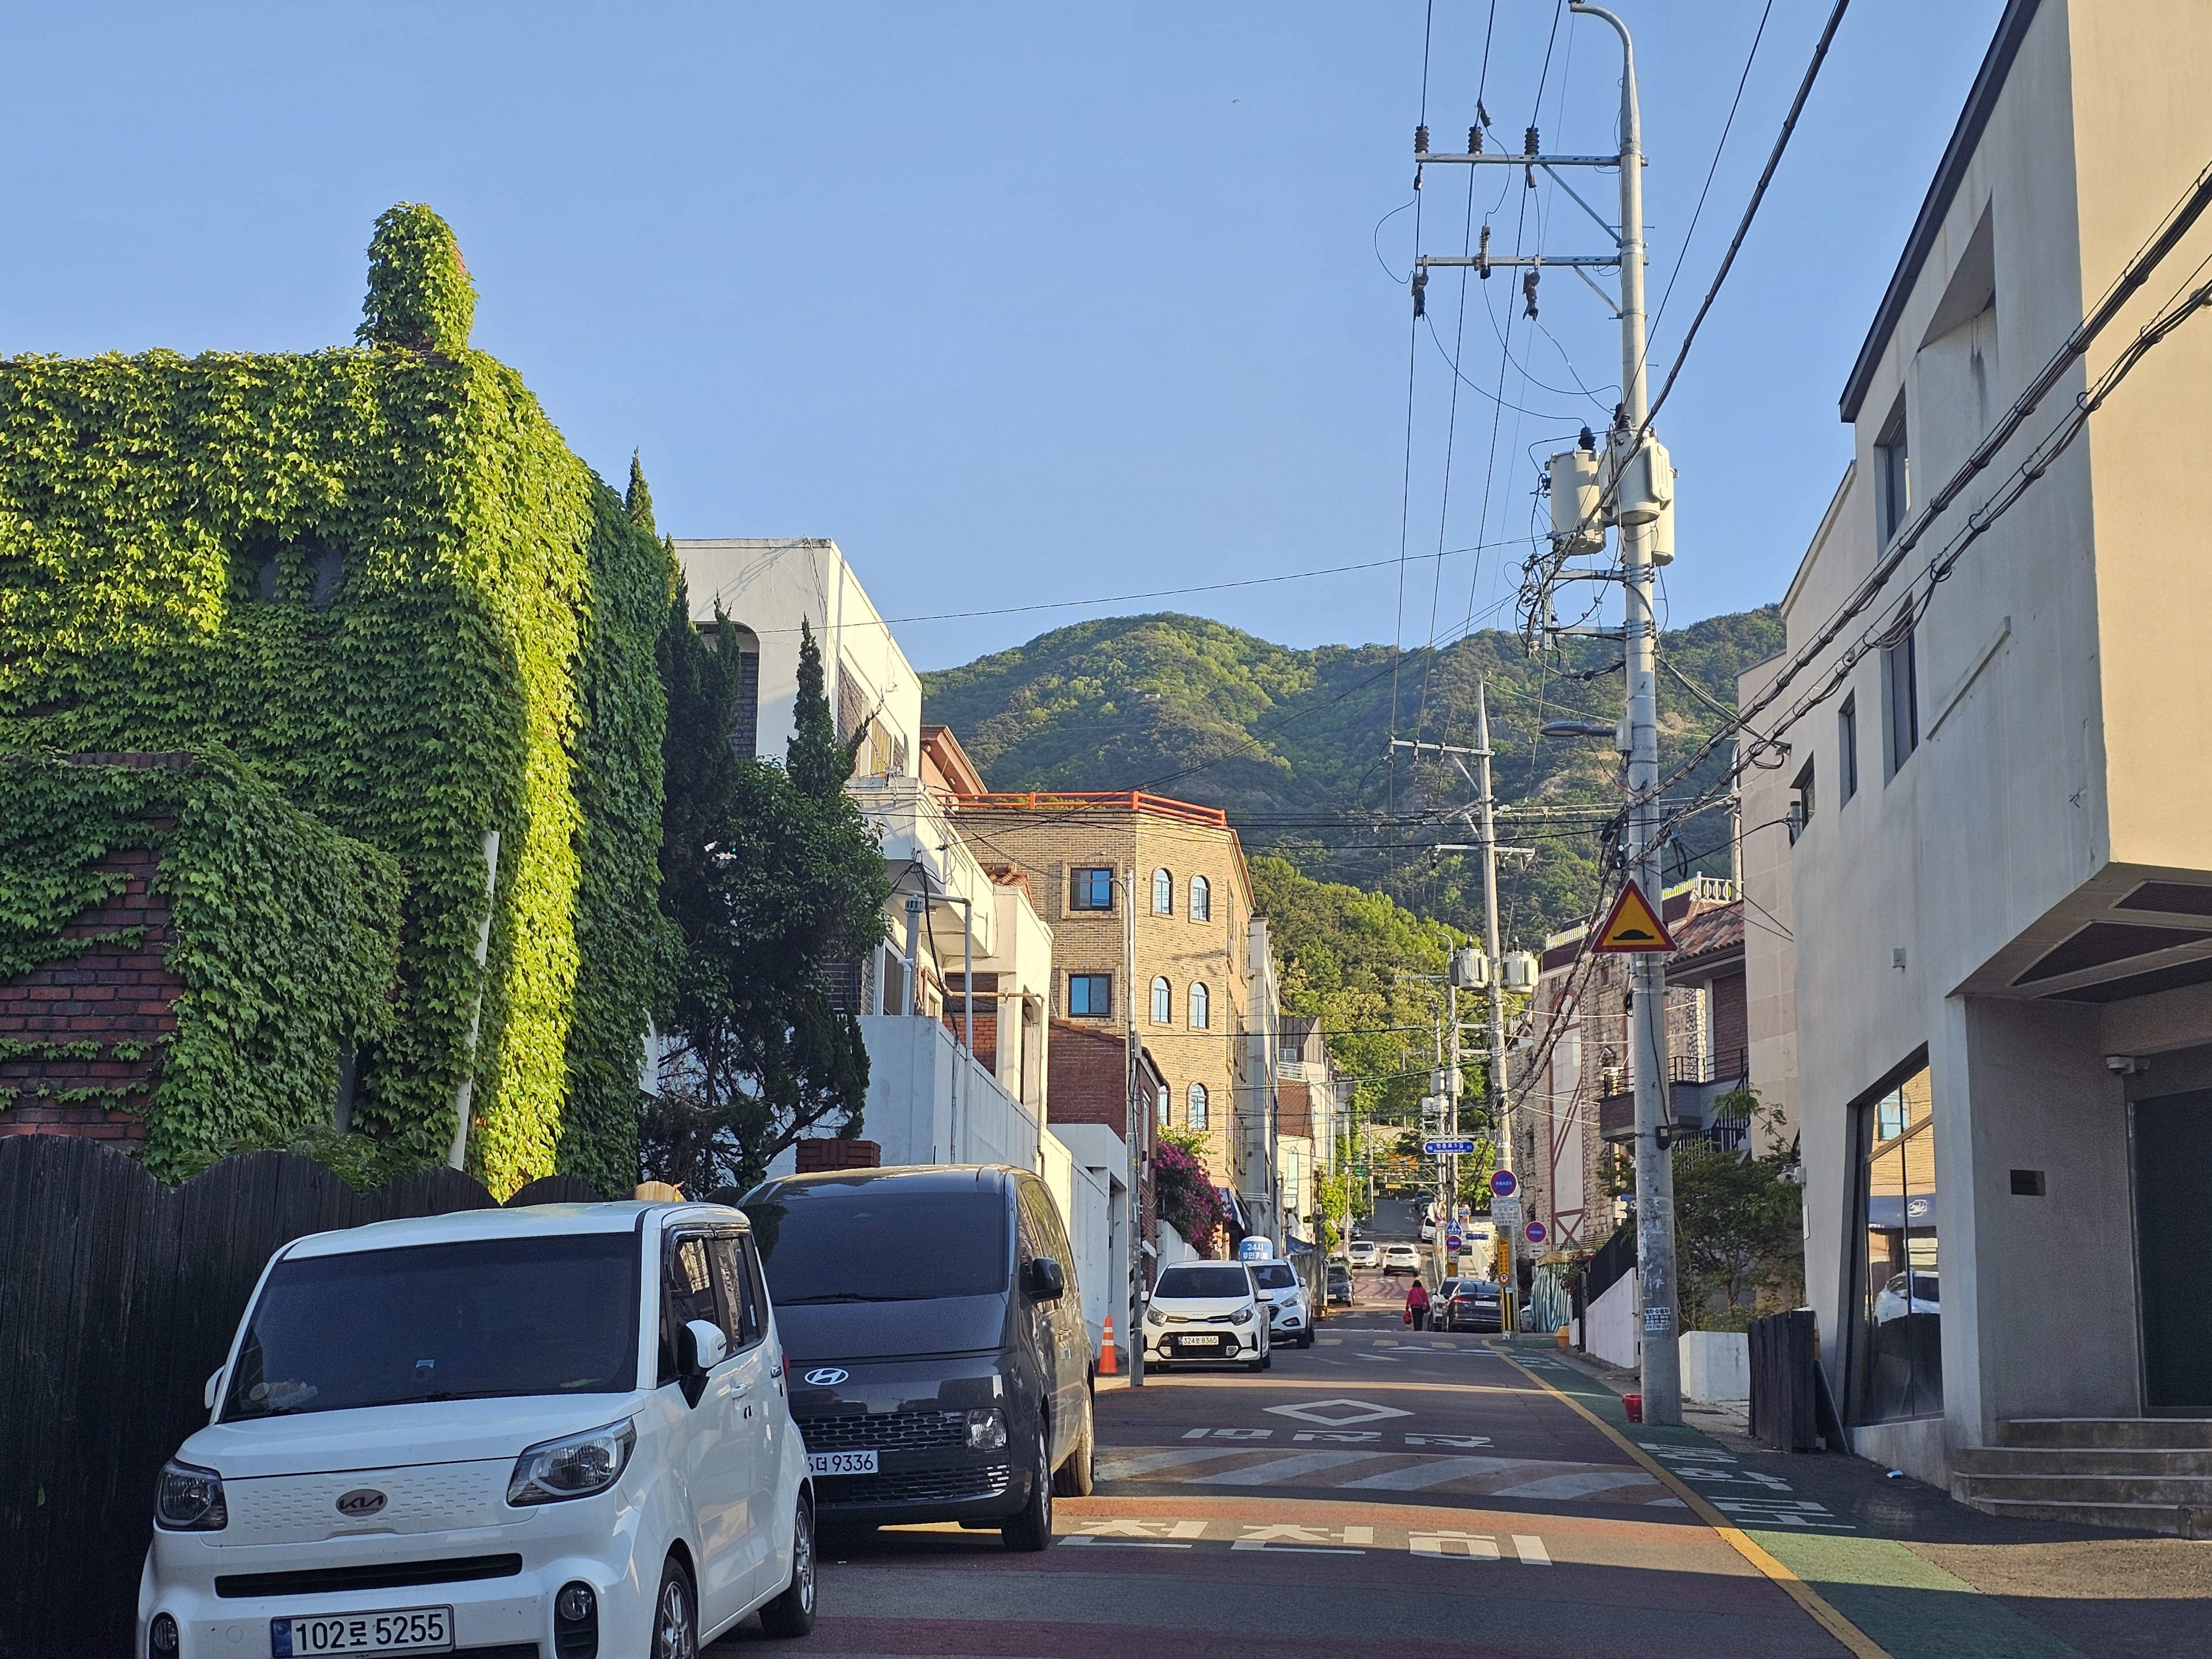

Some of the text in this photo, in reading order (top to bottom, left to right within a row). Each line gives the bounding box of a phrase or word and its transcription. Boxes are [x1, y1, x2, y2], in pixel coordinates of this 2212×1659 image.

[832, 1454, 874, 1472] 9336
[340, 1495, 384, 1509] KIA
[1057, 1519, 1553, 1566] 천천히
[296, 1614, 444, 1650] 102로 5255
